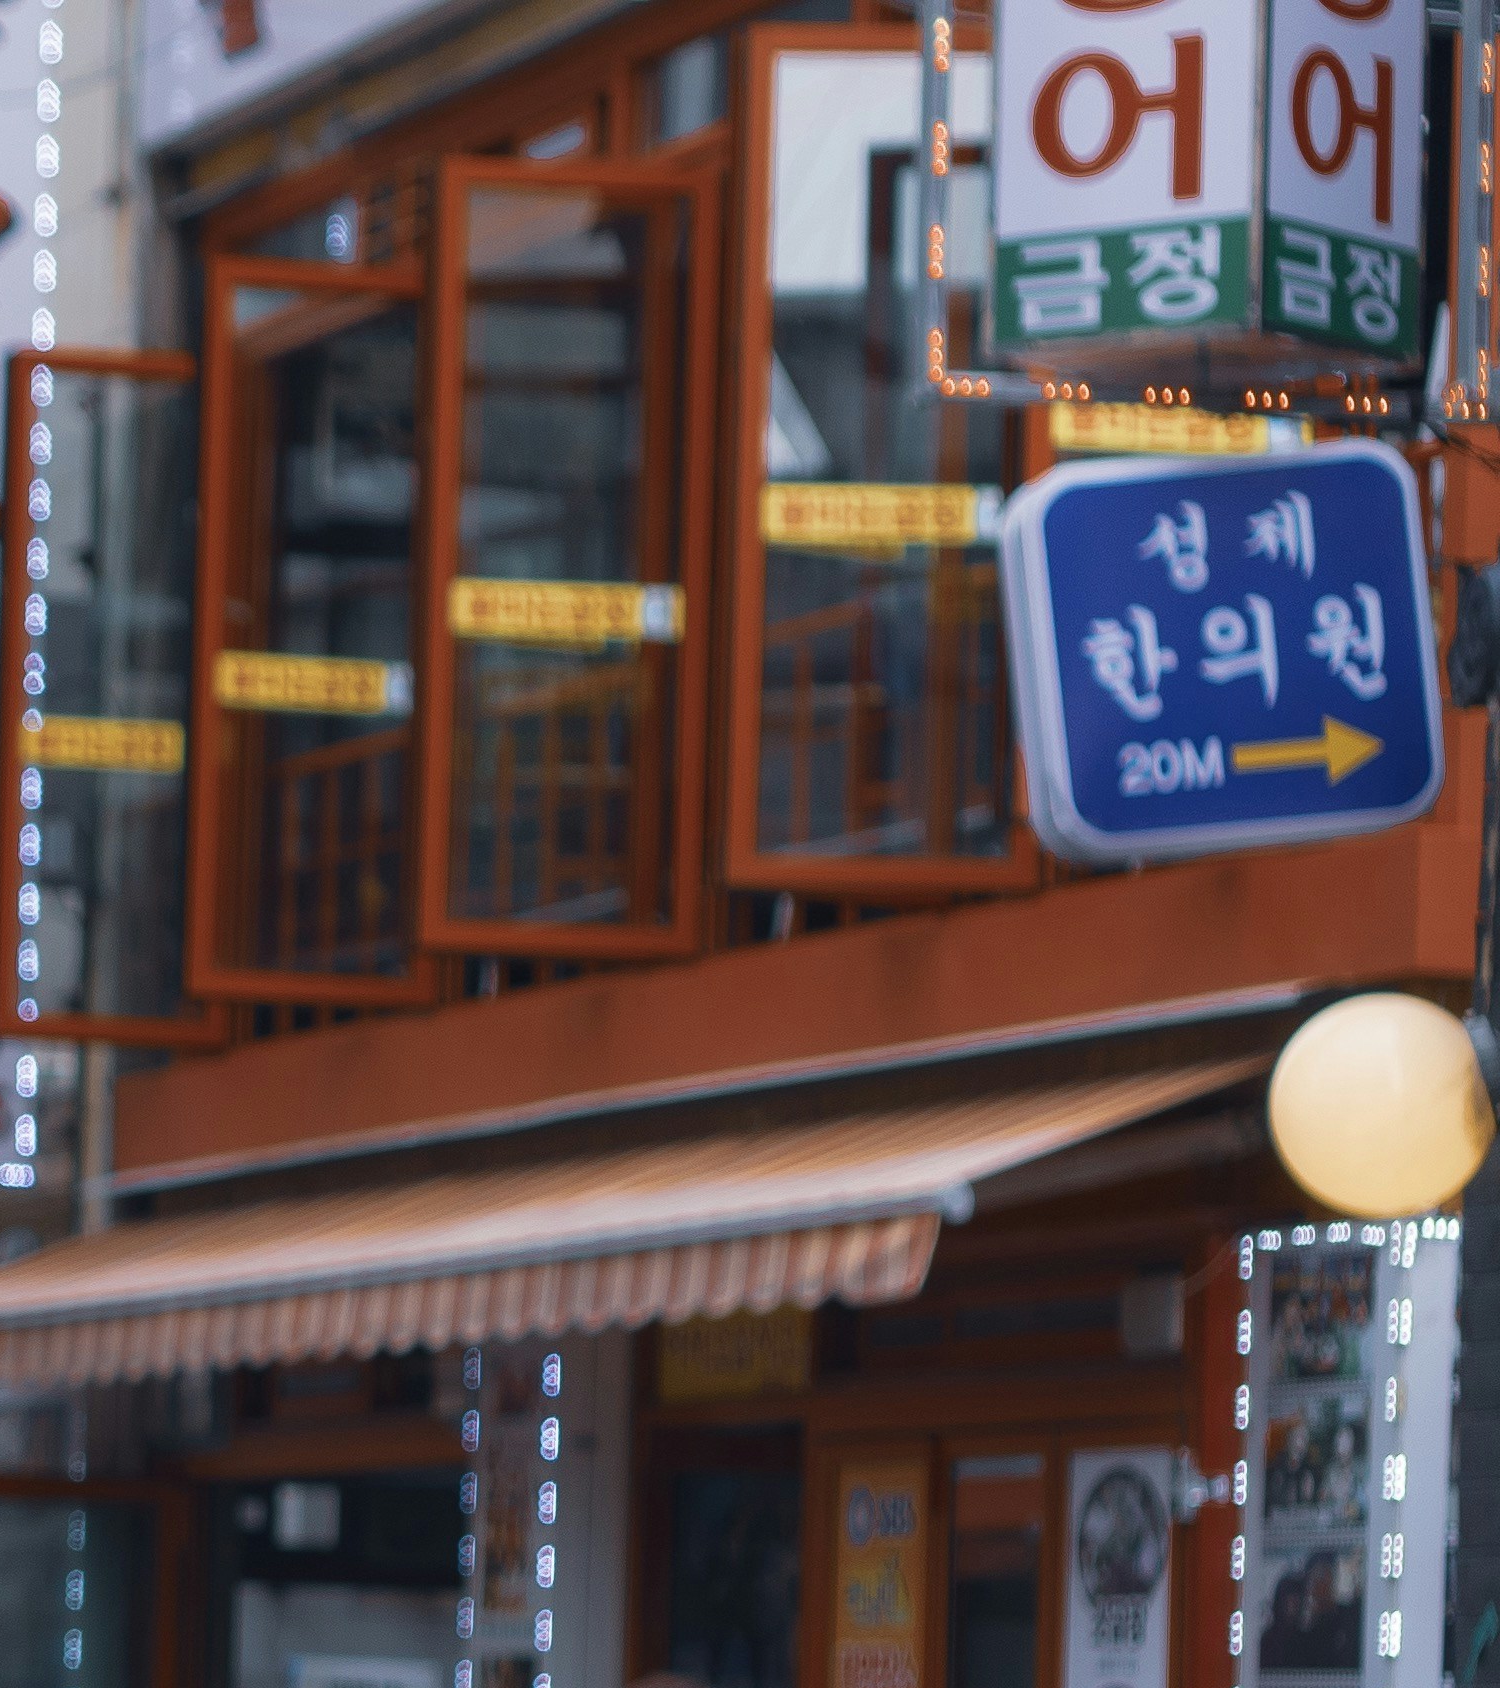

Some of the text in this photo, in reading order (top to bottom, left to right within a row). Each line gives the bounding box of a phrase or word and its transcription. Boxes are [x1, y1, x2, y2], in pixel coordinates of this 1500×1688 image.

[1031, 0, 1206, 201] 어
[1290, 0, 1395, 226] 어
[1013, 223, 1222, 331] 금정
[1274, 226, 1401, 345] 금정
[1083, 583, 1389, 722] 한의원
[1118, 736, 1225, 797] 20M
